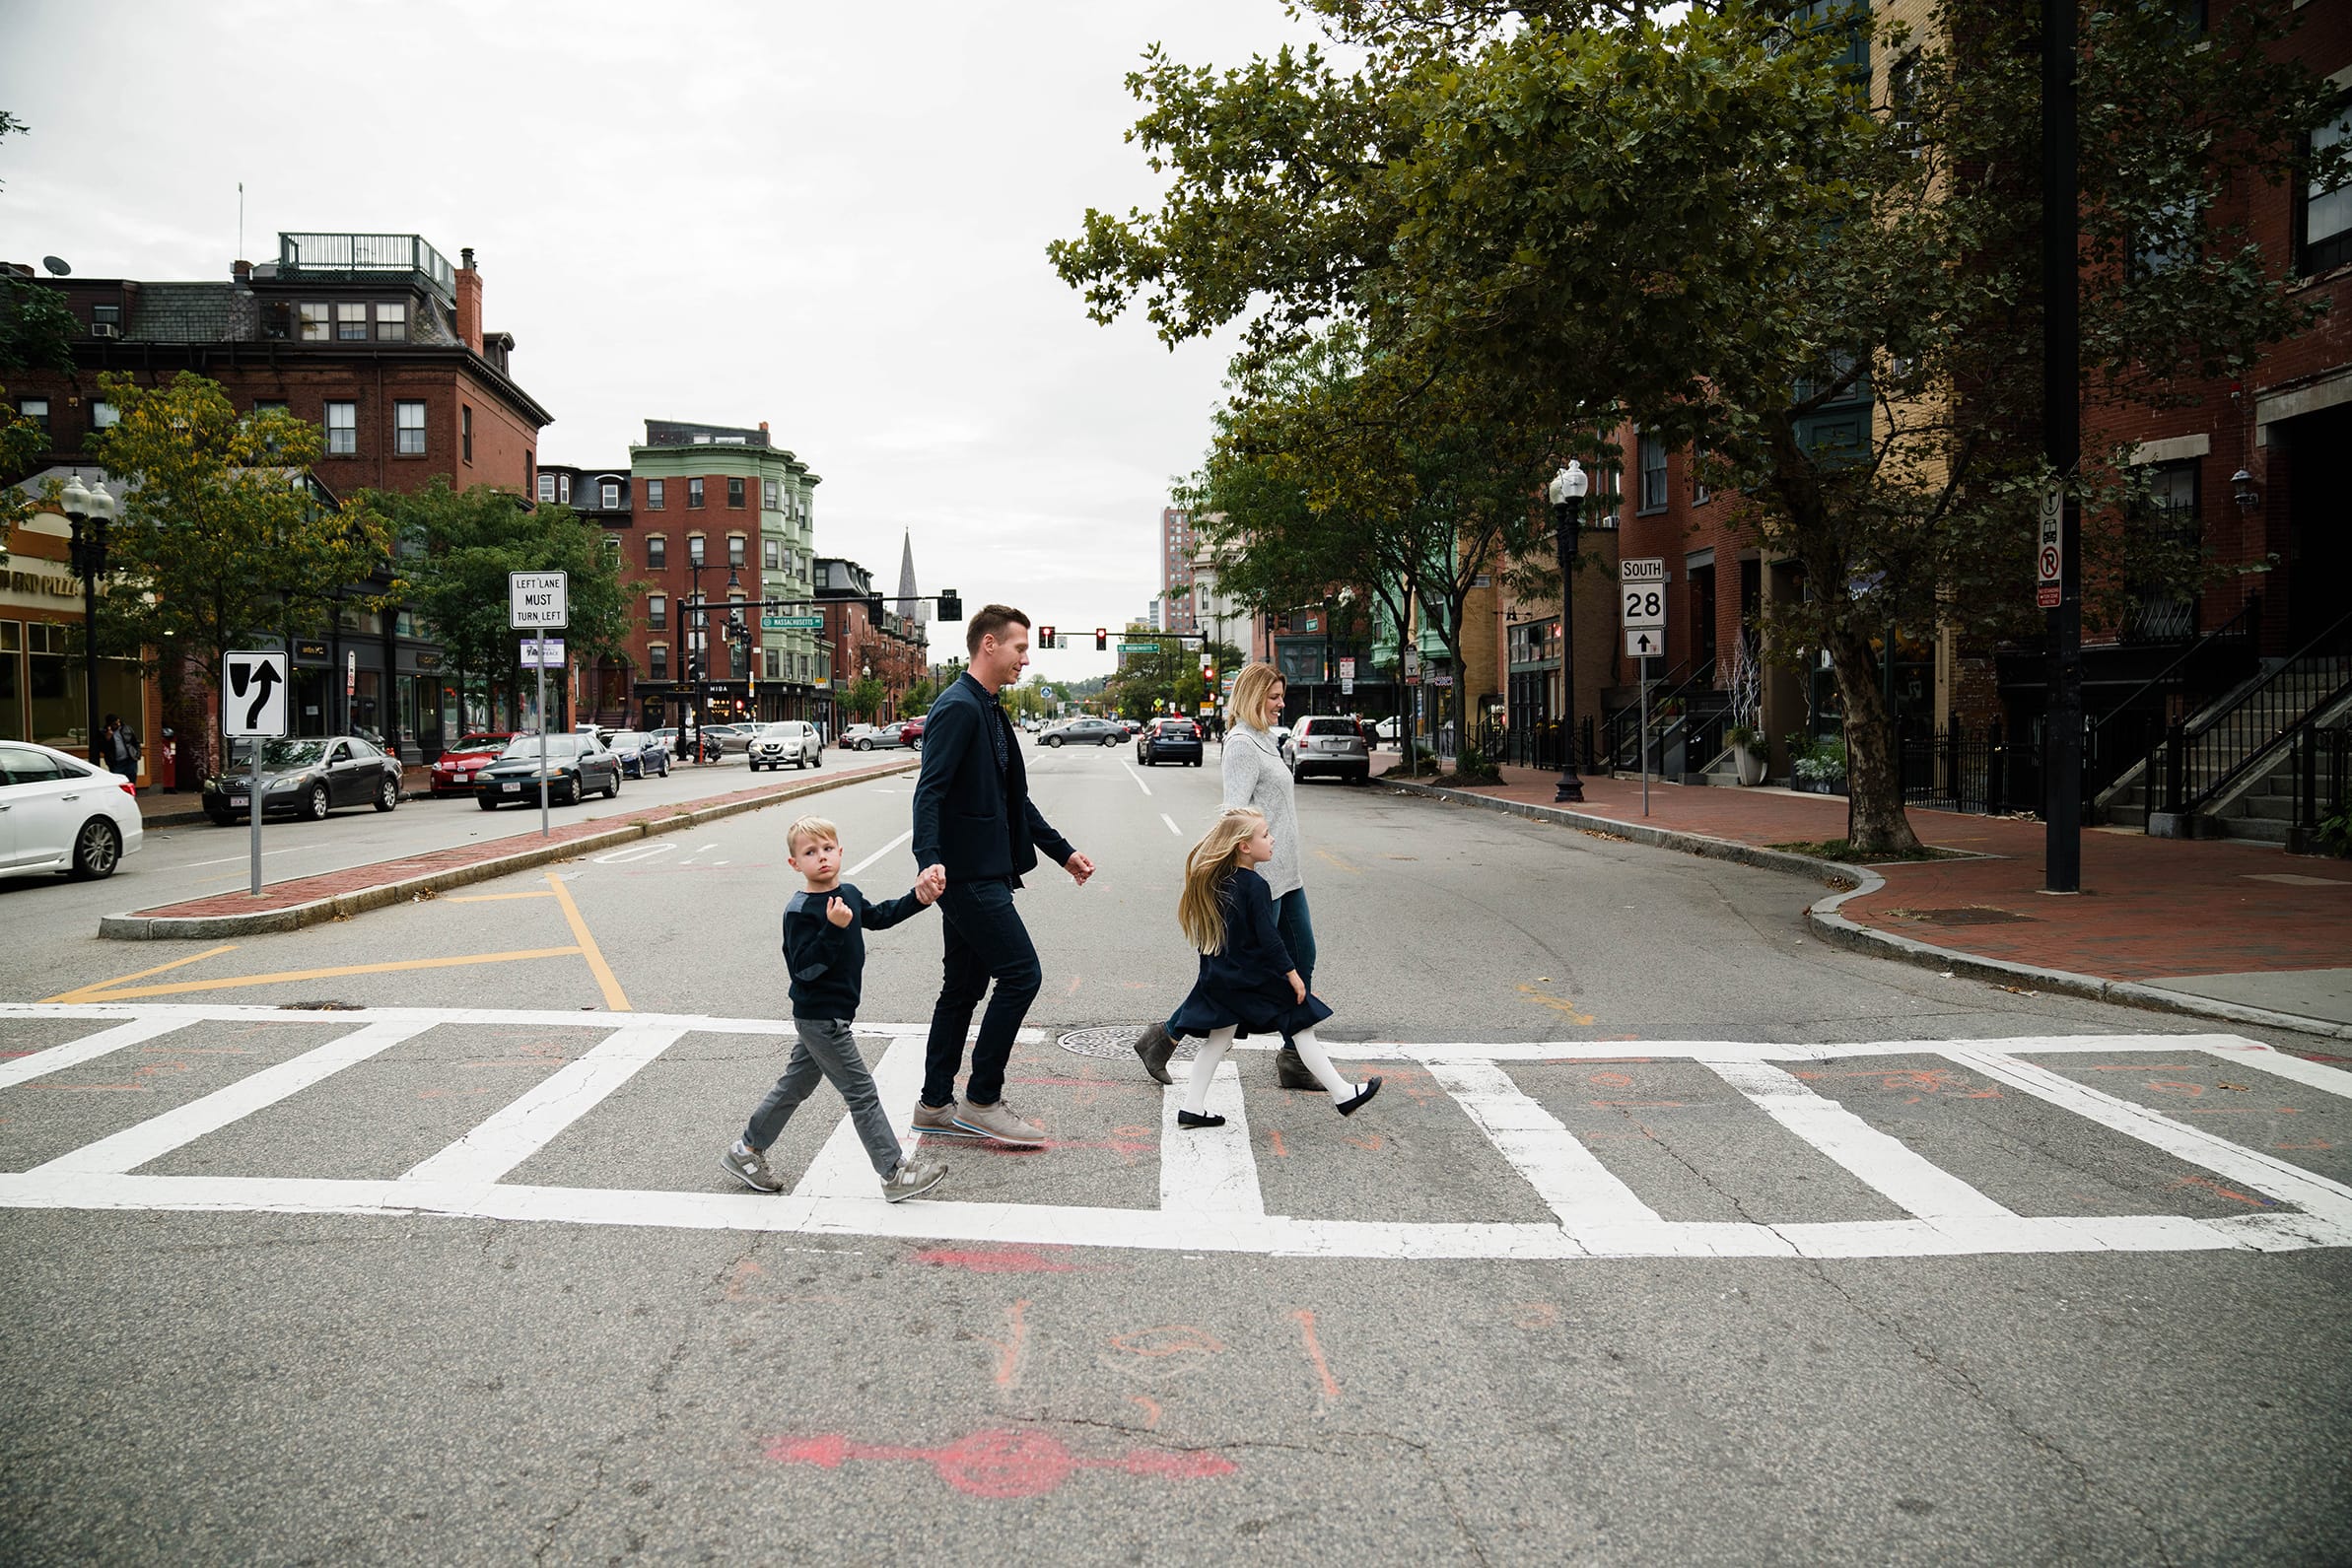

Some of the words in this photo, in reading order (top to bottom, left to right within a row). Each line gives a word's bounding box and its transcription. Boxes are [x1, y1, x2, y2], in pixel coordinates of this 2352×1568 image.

[1624, 562, 1661, 577] SOUTH
[517, 579, 535, 588] LEFT
[539, 579, 560, 588] LANE
[525, 594, 552, 605] MUST
[1626, 592, 1661, 617] 28
[518, 611, 538, 621] TURN
[542, 611, 560, 621] LEFT
